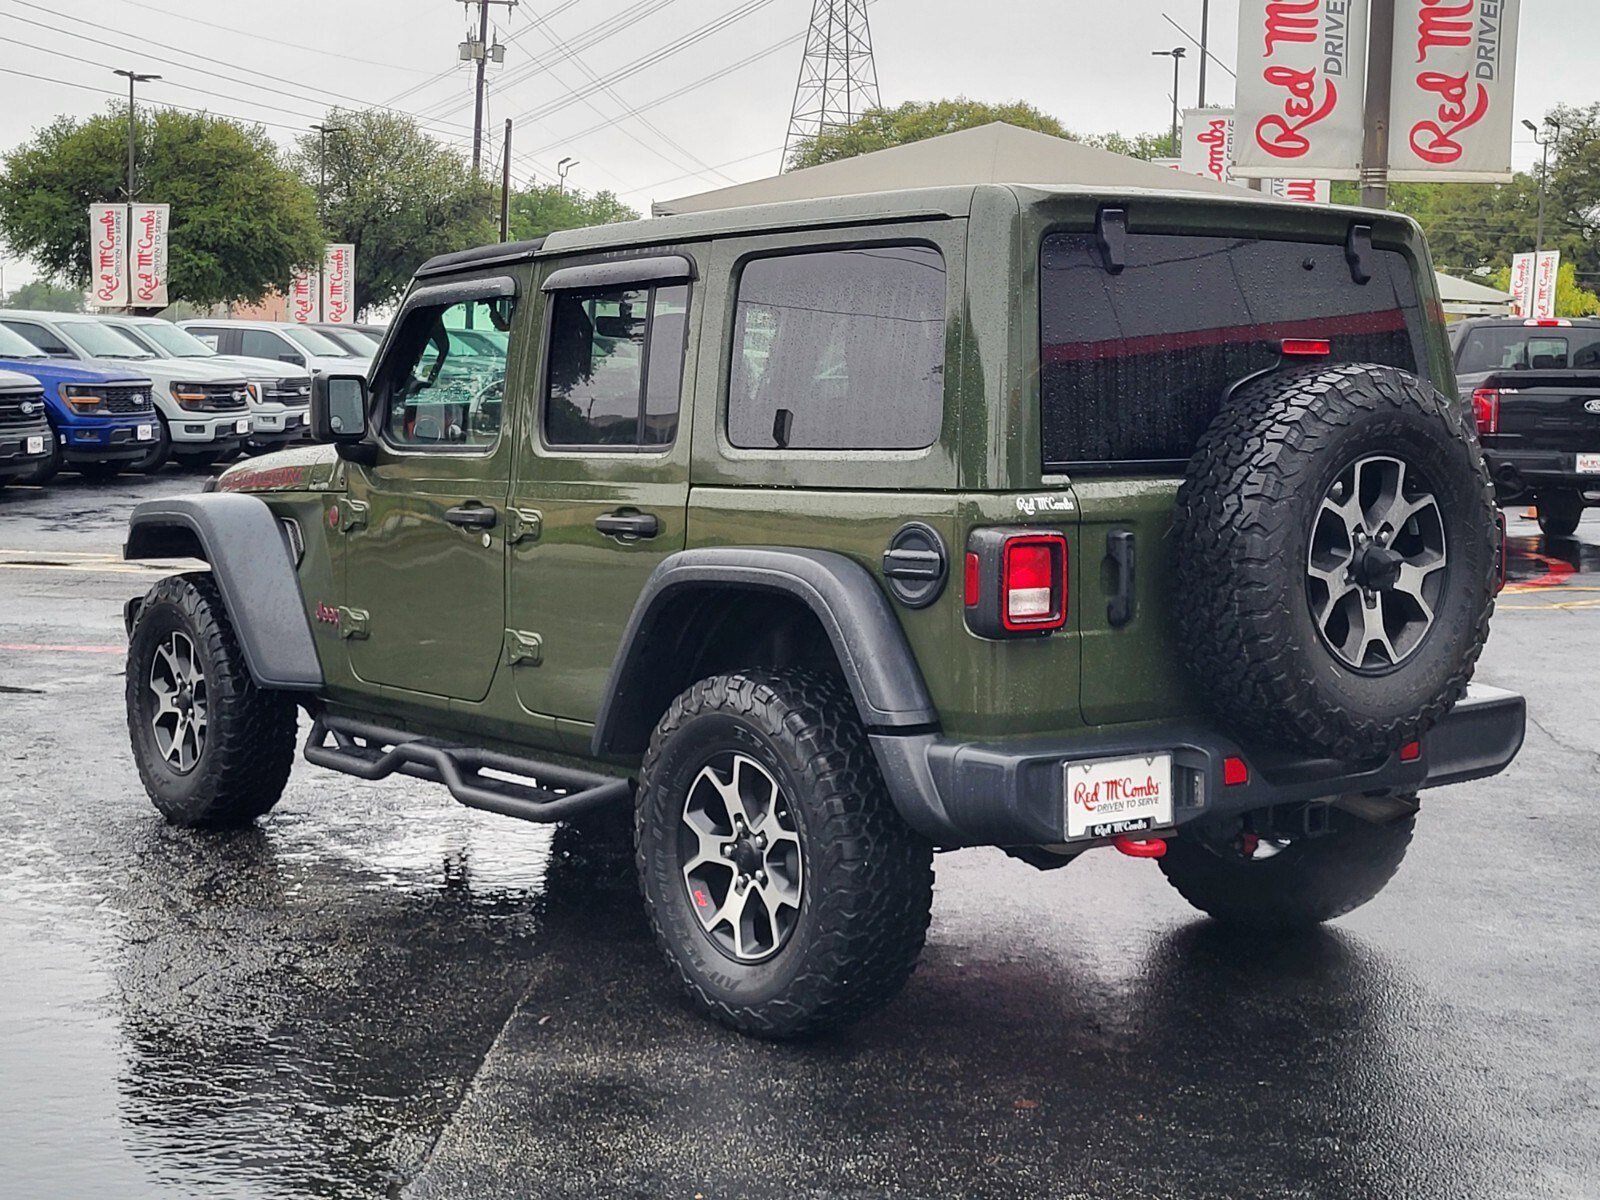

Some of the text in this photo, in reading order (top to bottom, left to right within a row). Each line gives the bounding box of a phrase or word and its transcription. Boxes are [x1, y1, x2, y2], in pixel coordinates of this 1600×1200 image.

[1475, 0, 1498, 80] DRIVE
[1255, 66, 1337, 158] Red
[1409, 71, 1489, 163] Red
[97, 210, 119, 301] Red McCombs
[137, 210, 158, 300] Red McCombs
[329, 249, 347, 322] Red McCombs
[295, 300, 313, 322] Red
[1016, 497, 1036, 515] Red
[1074, 775, 1159, 811] Red McCombs
[1097, 796, 1159, 813] DRIVEN TO SERVE
